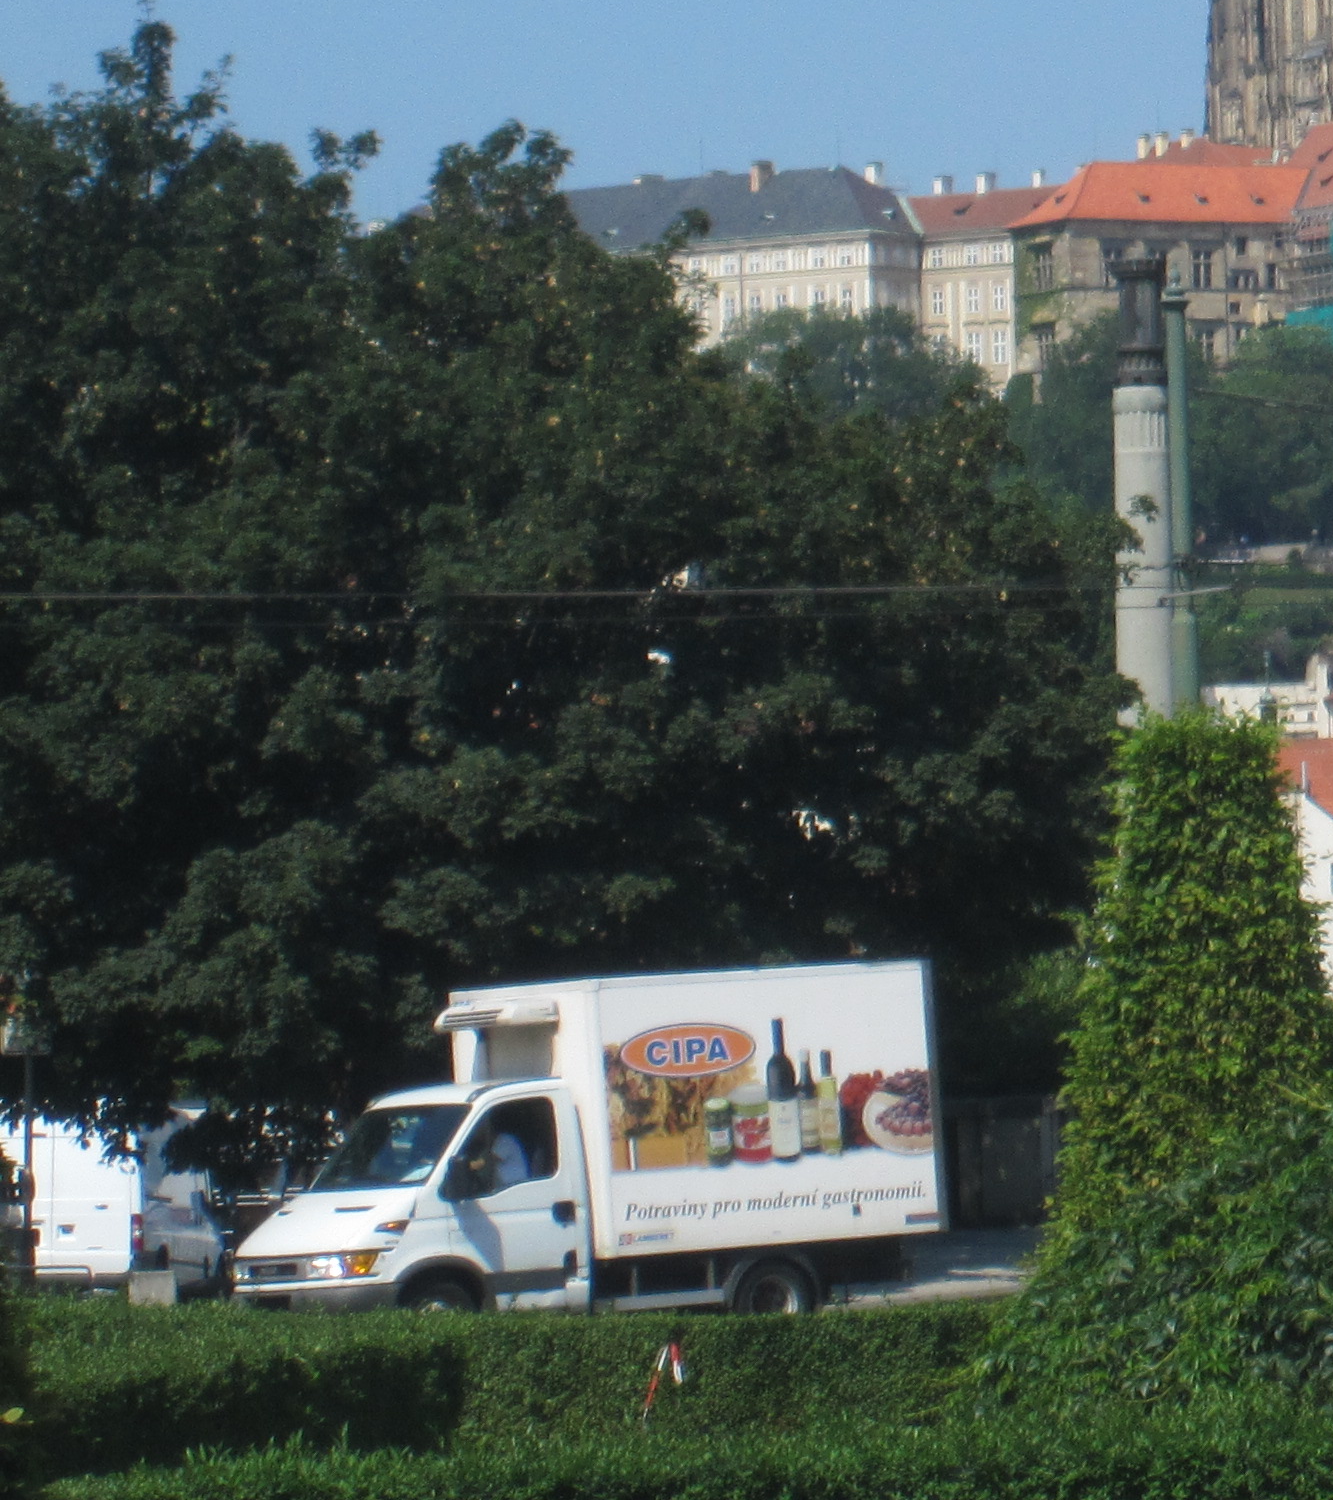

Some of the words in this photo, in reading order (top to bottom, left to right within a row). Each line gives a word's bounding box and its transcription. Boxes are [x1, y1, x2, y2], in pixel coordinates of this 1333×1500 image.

[645, 1036, 731, 1067] CIPA
[625, 1199, 707, 1221] Potraviny
[711, 1199, 742, 1219] pro
[747, 1188, 818, 1211] moderní
[822, 1181, 927, 1210] gastronomii.
